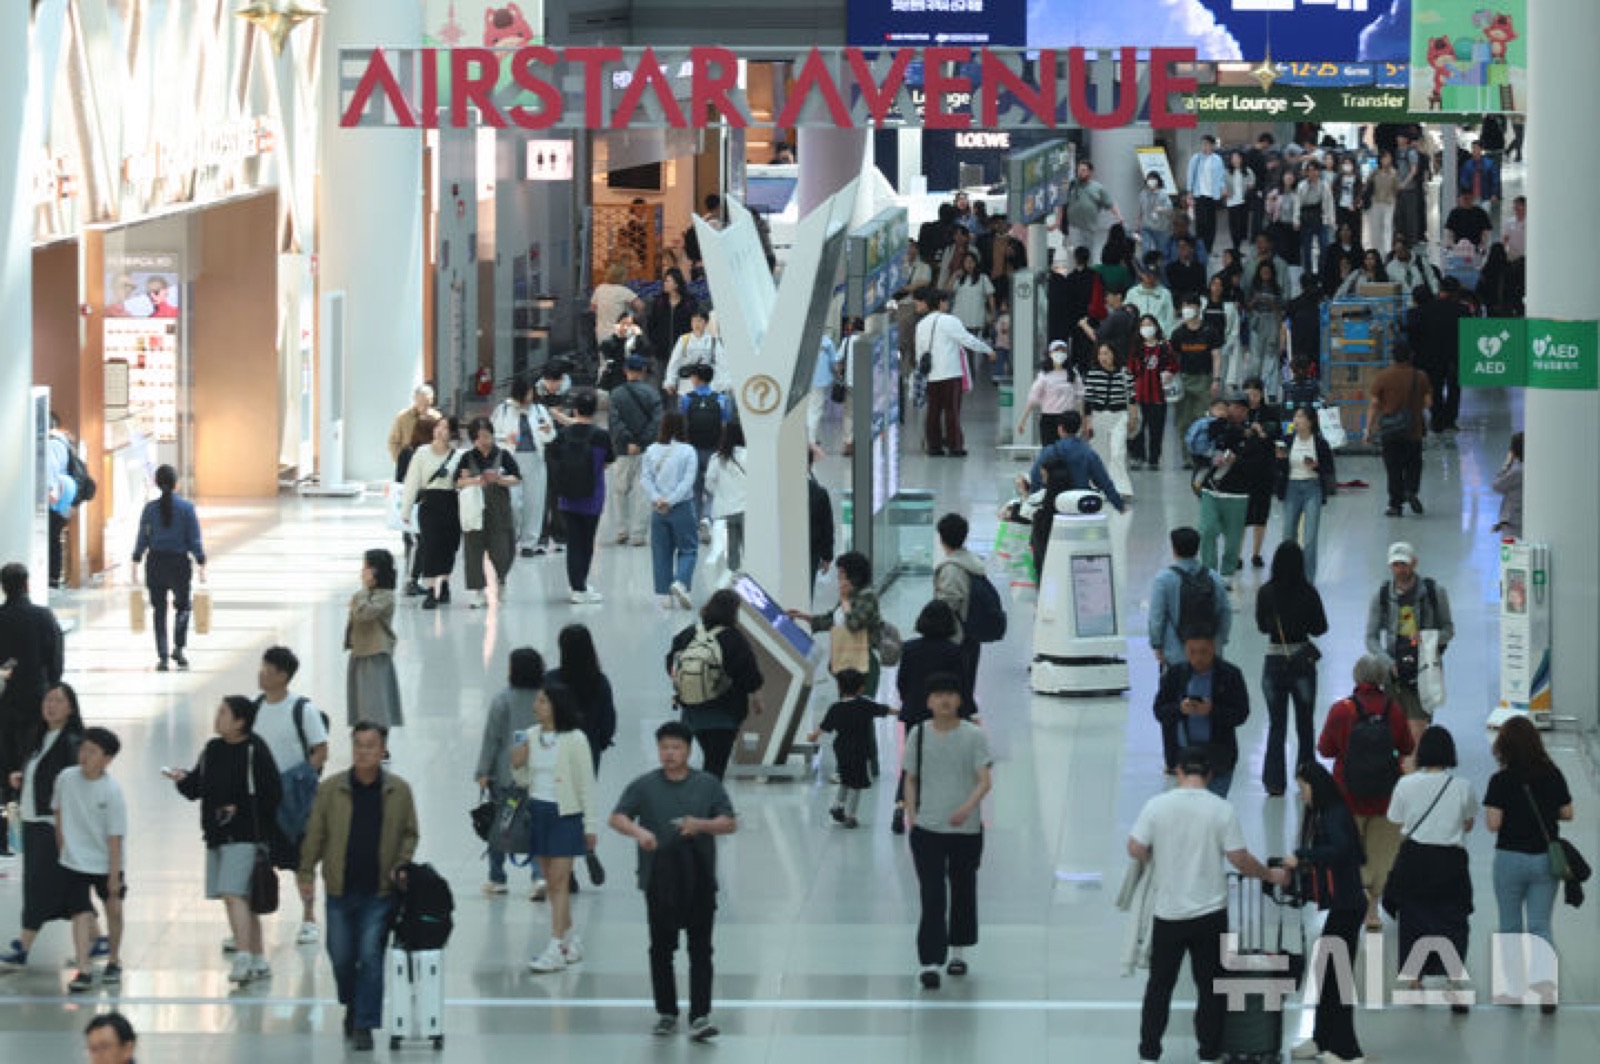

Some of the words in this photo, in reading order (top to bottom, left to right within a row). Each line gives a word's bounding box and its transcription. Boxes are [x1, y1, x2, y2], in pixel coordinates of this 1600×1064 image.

[339, 45, 749, 130] AIRSTAR
[776, 45, 1198, 129] AVENUE
[1232, 94, 1288, 114] Lounge
[1341, 92, 1404, 108] Transfer
[955, 132, 1010, 148] LOEWE
[1547, 343, 1579, 359] AED
[1474, 361, 1506, 374] AED
